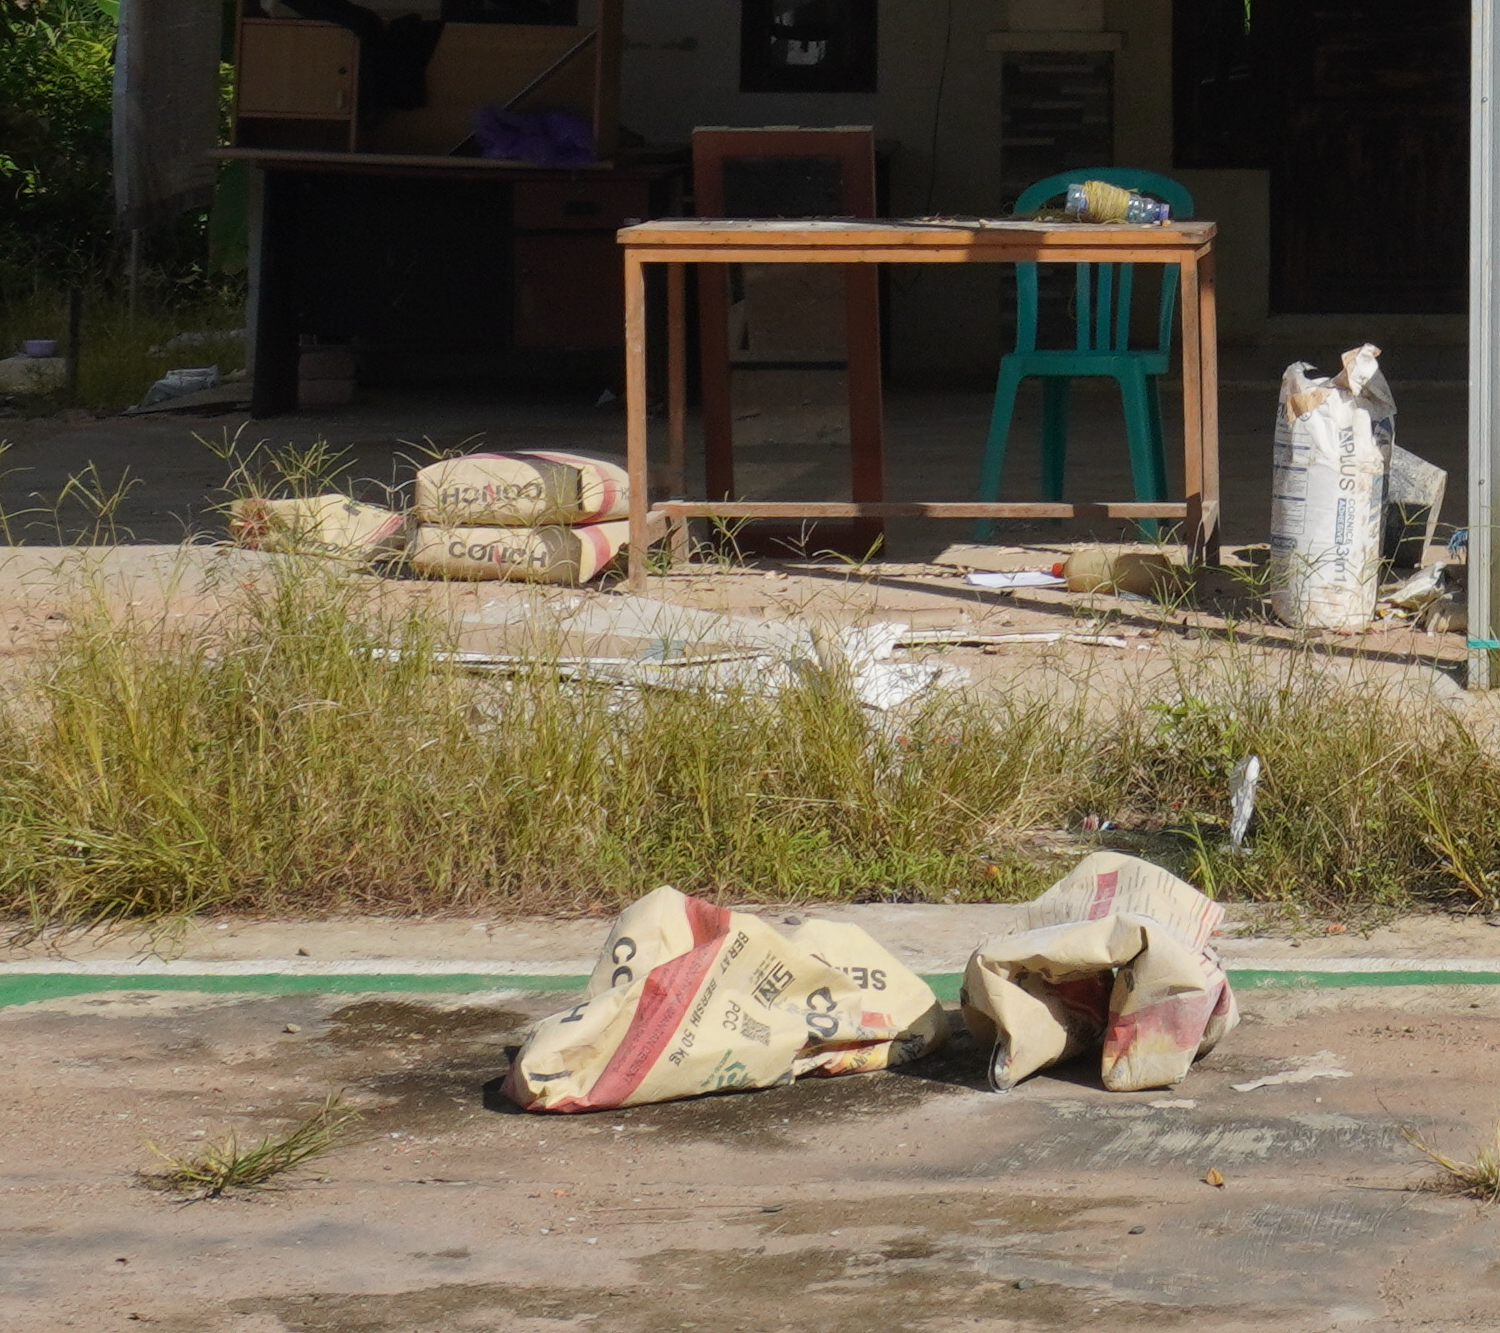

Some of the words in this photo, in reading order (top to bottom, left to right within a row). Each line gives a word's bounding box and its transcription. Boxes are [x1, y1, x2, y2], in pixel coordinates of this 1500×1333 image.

[1338, 425, 1356, 491] APLUS
[442, 483, 544, 505] CONCH
[1345, 498, 1356, 546] CORNICE
[448, 541, 548, 568] CONCH
[720, 930, 750, 975] BERAT
[686, 978, 718, 1034] BERSIH
[722, 999, 742, 1031] PCC
[682, 1028, 697, 1049] 50
